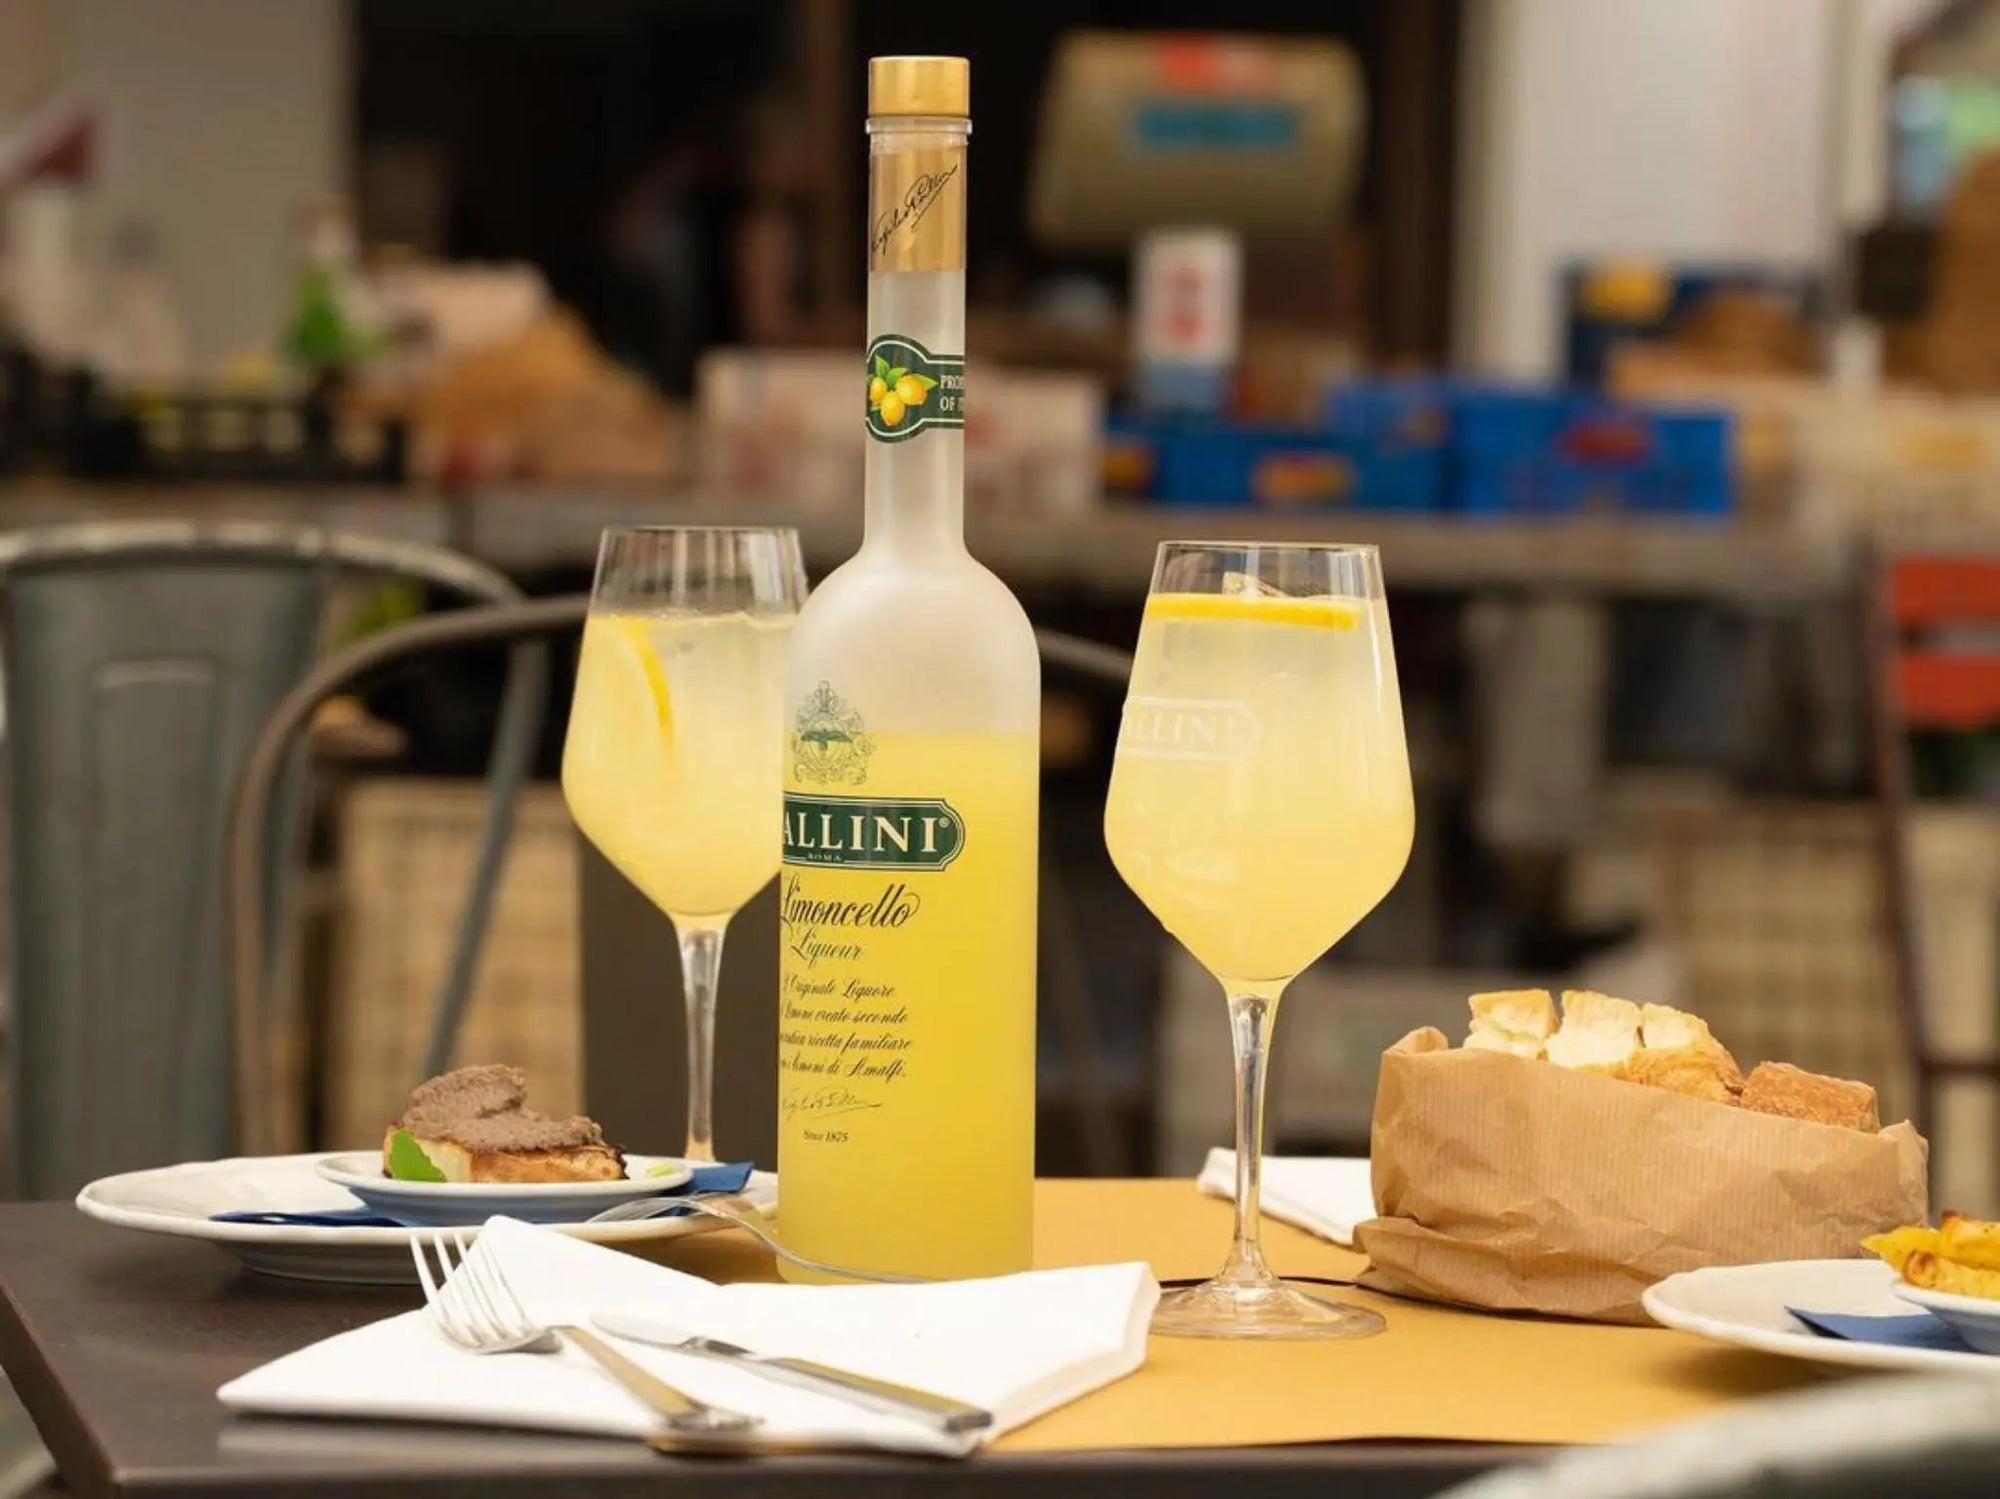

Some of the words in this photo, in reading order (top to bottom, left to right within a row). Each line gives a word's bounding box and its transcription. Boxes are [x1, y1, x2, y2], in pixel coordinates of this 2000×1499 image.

[940, 397, 955, 411] OF
[781, 874, 920, 931] Limoncello
[791, 926, 862, 969] Liqueur
[841, 978, 895, 1003] Liquore
[840, 1032, 911, 1056] familiare
